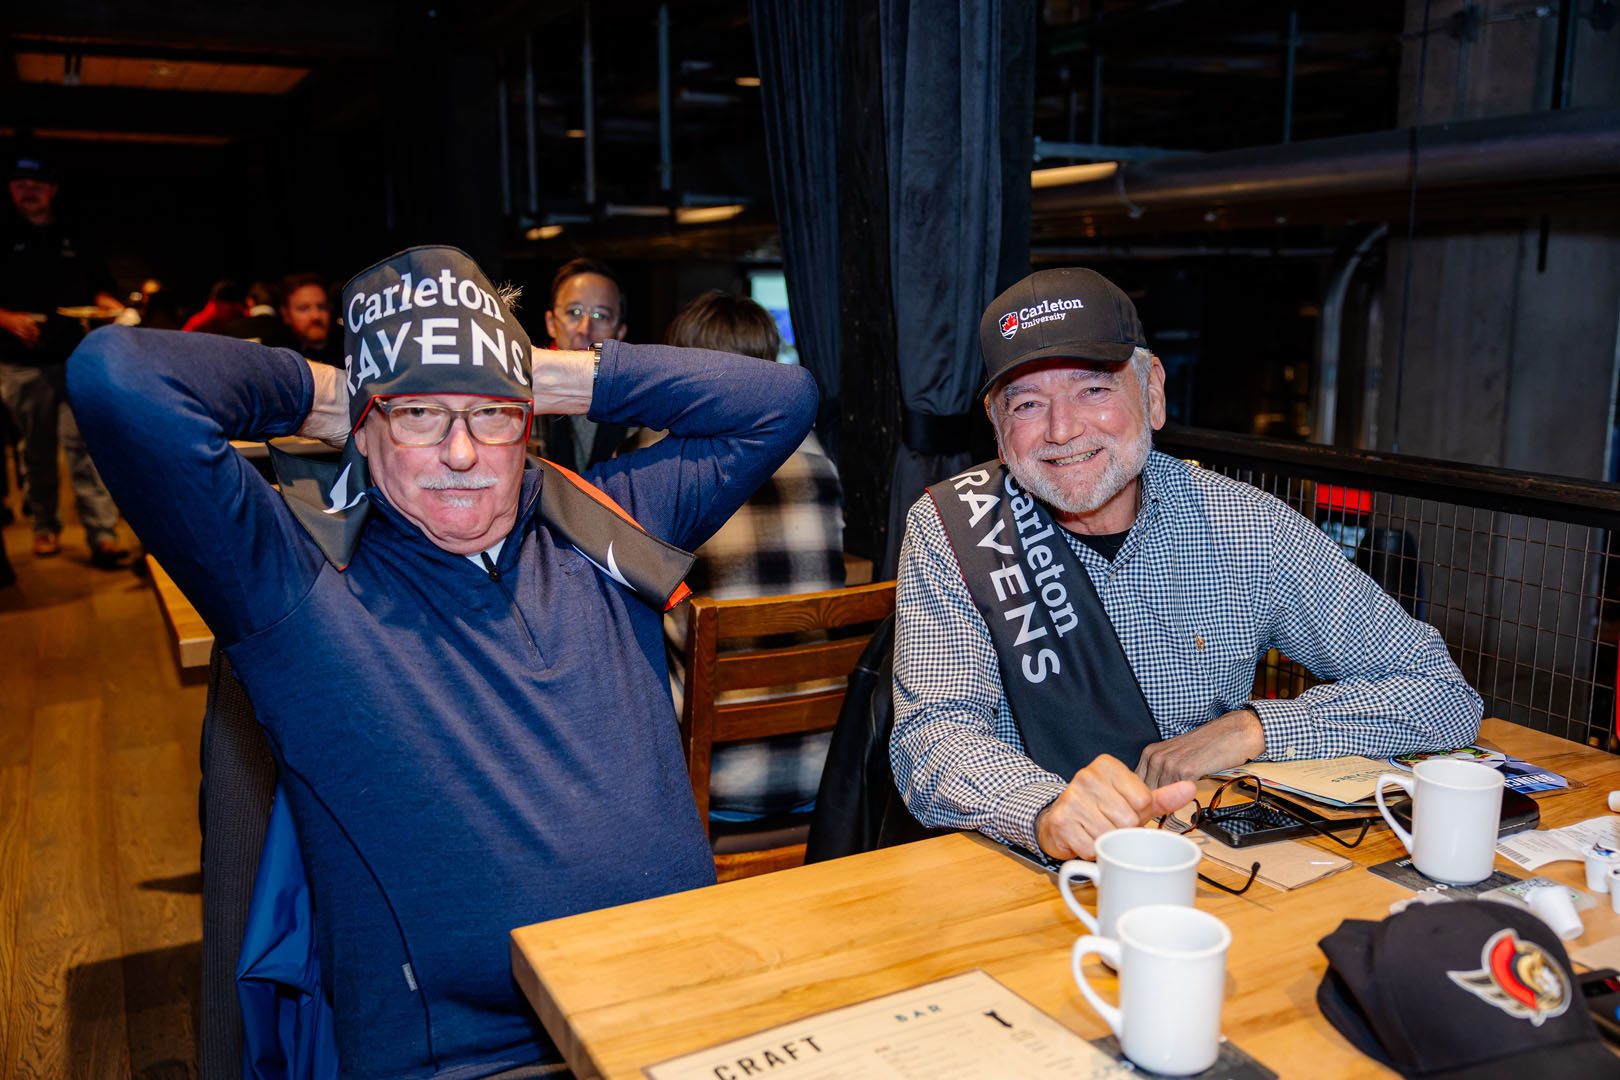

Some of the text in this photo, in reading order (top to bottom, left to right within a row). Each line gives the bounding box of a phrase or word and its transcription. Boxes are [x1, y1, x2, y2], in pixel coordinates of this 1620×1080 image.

[348, 269, 505, 334] Carleton
[1019, 298, 1085, 321] Carleton
[1021, 312, 1067, 330] University
[950, 469, 1061, 684] RAVENS
[714, 1036, 822, 1080] CRAFT
